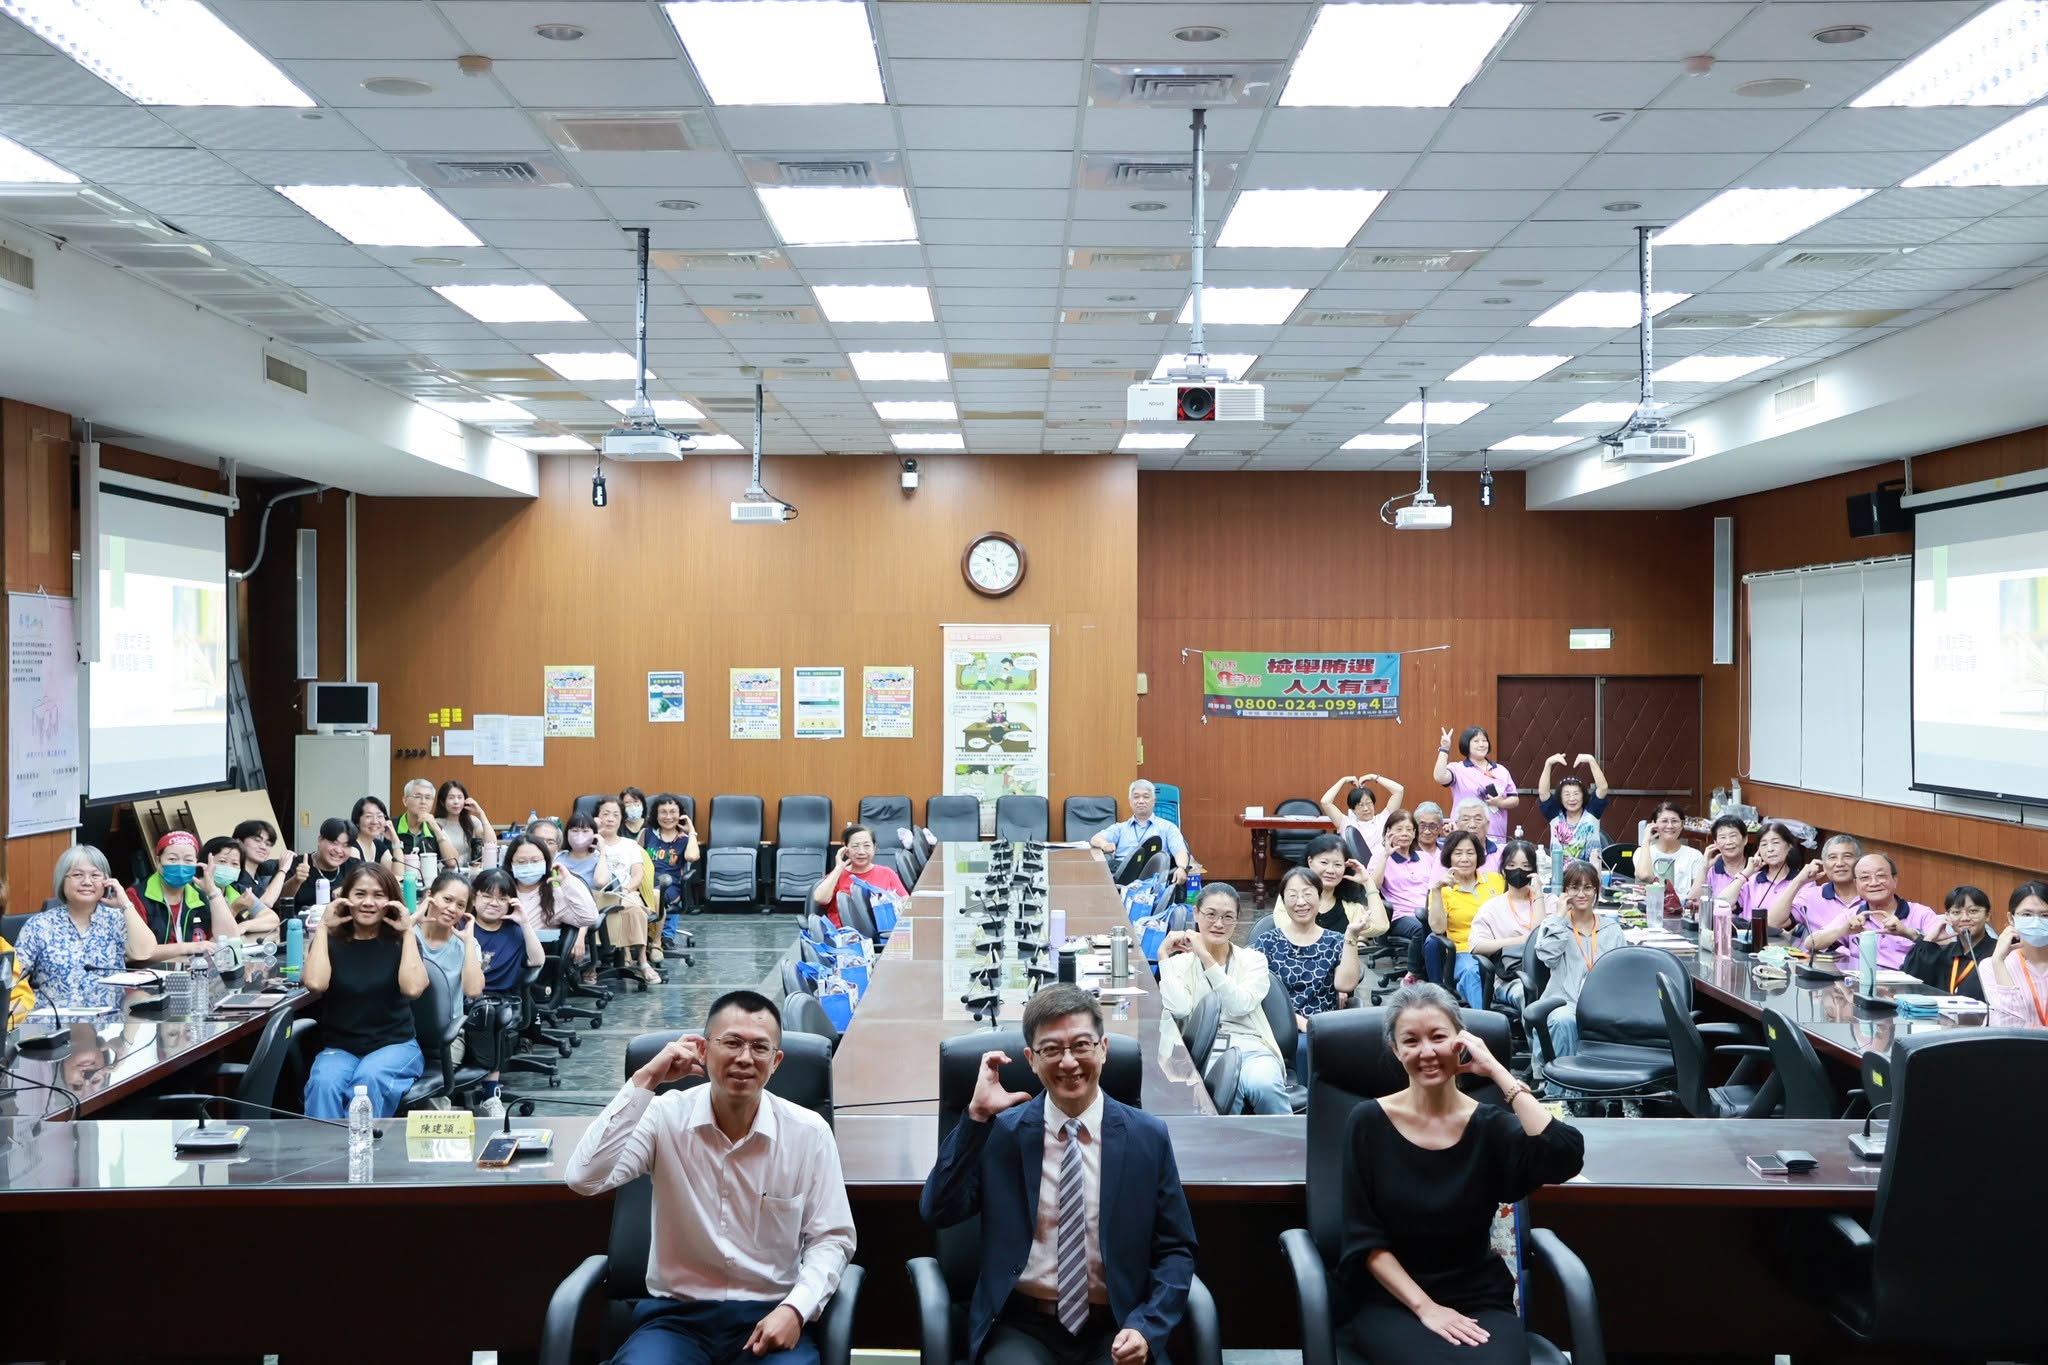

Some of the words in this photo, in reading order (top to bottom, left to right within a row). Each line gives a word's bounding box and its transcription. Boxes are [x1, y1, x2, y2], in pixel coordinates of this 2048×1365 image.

[1268, 658, 1376, 674] 檢舉賄選
[1283, 678, 1390, 695] 人人有責
